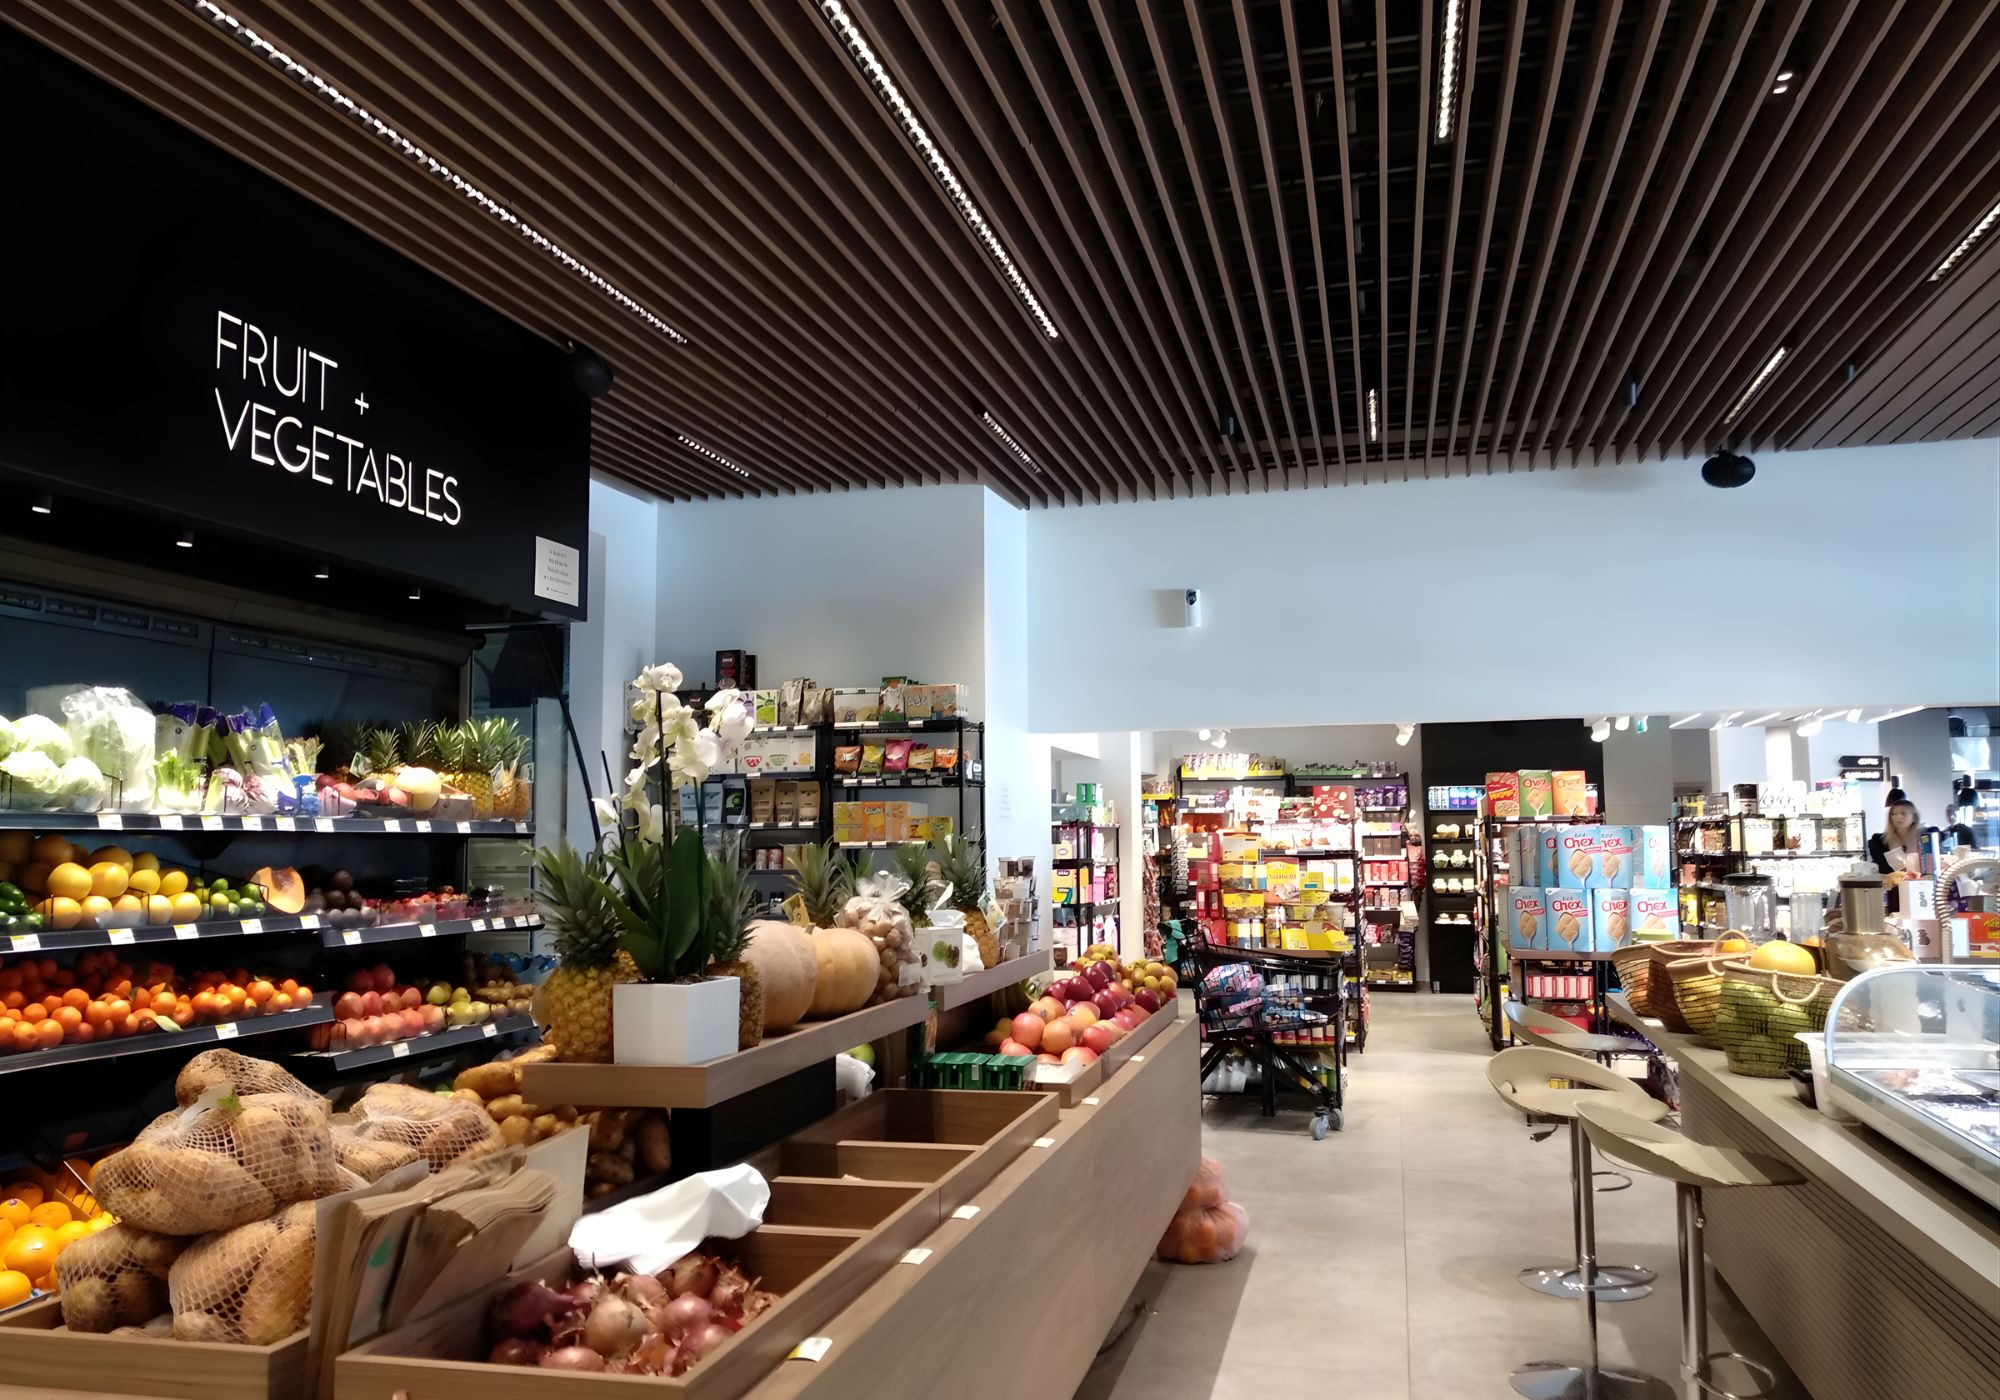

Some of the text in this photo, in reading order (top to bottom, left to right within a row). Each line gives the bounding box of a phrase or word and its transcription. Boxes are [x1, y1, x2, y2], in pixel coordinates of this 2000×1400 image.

[216, 310, 338, 411] FRUIT
[215, 387, 462, 526] VEGETABLES
[1564, 837, 1594, 849] Chex
[1552, 900, 1582, 911] Chex
[1637, 901, 1667, 912] Chex
